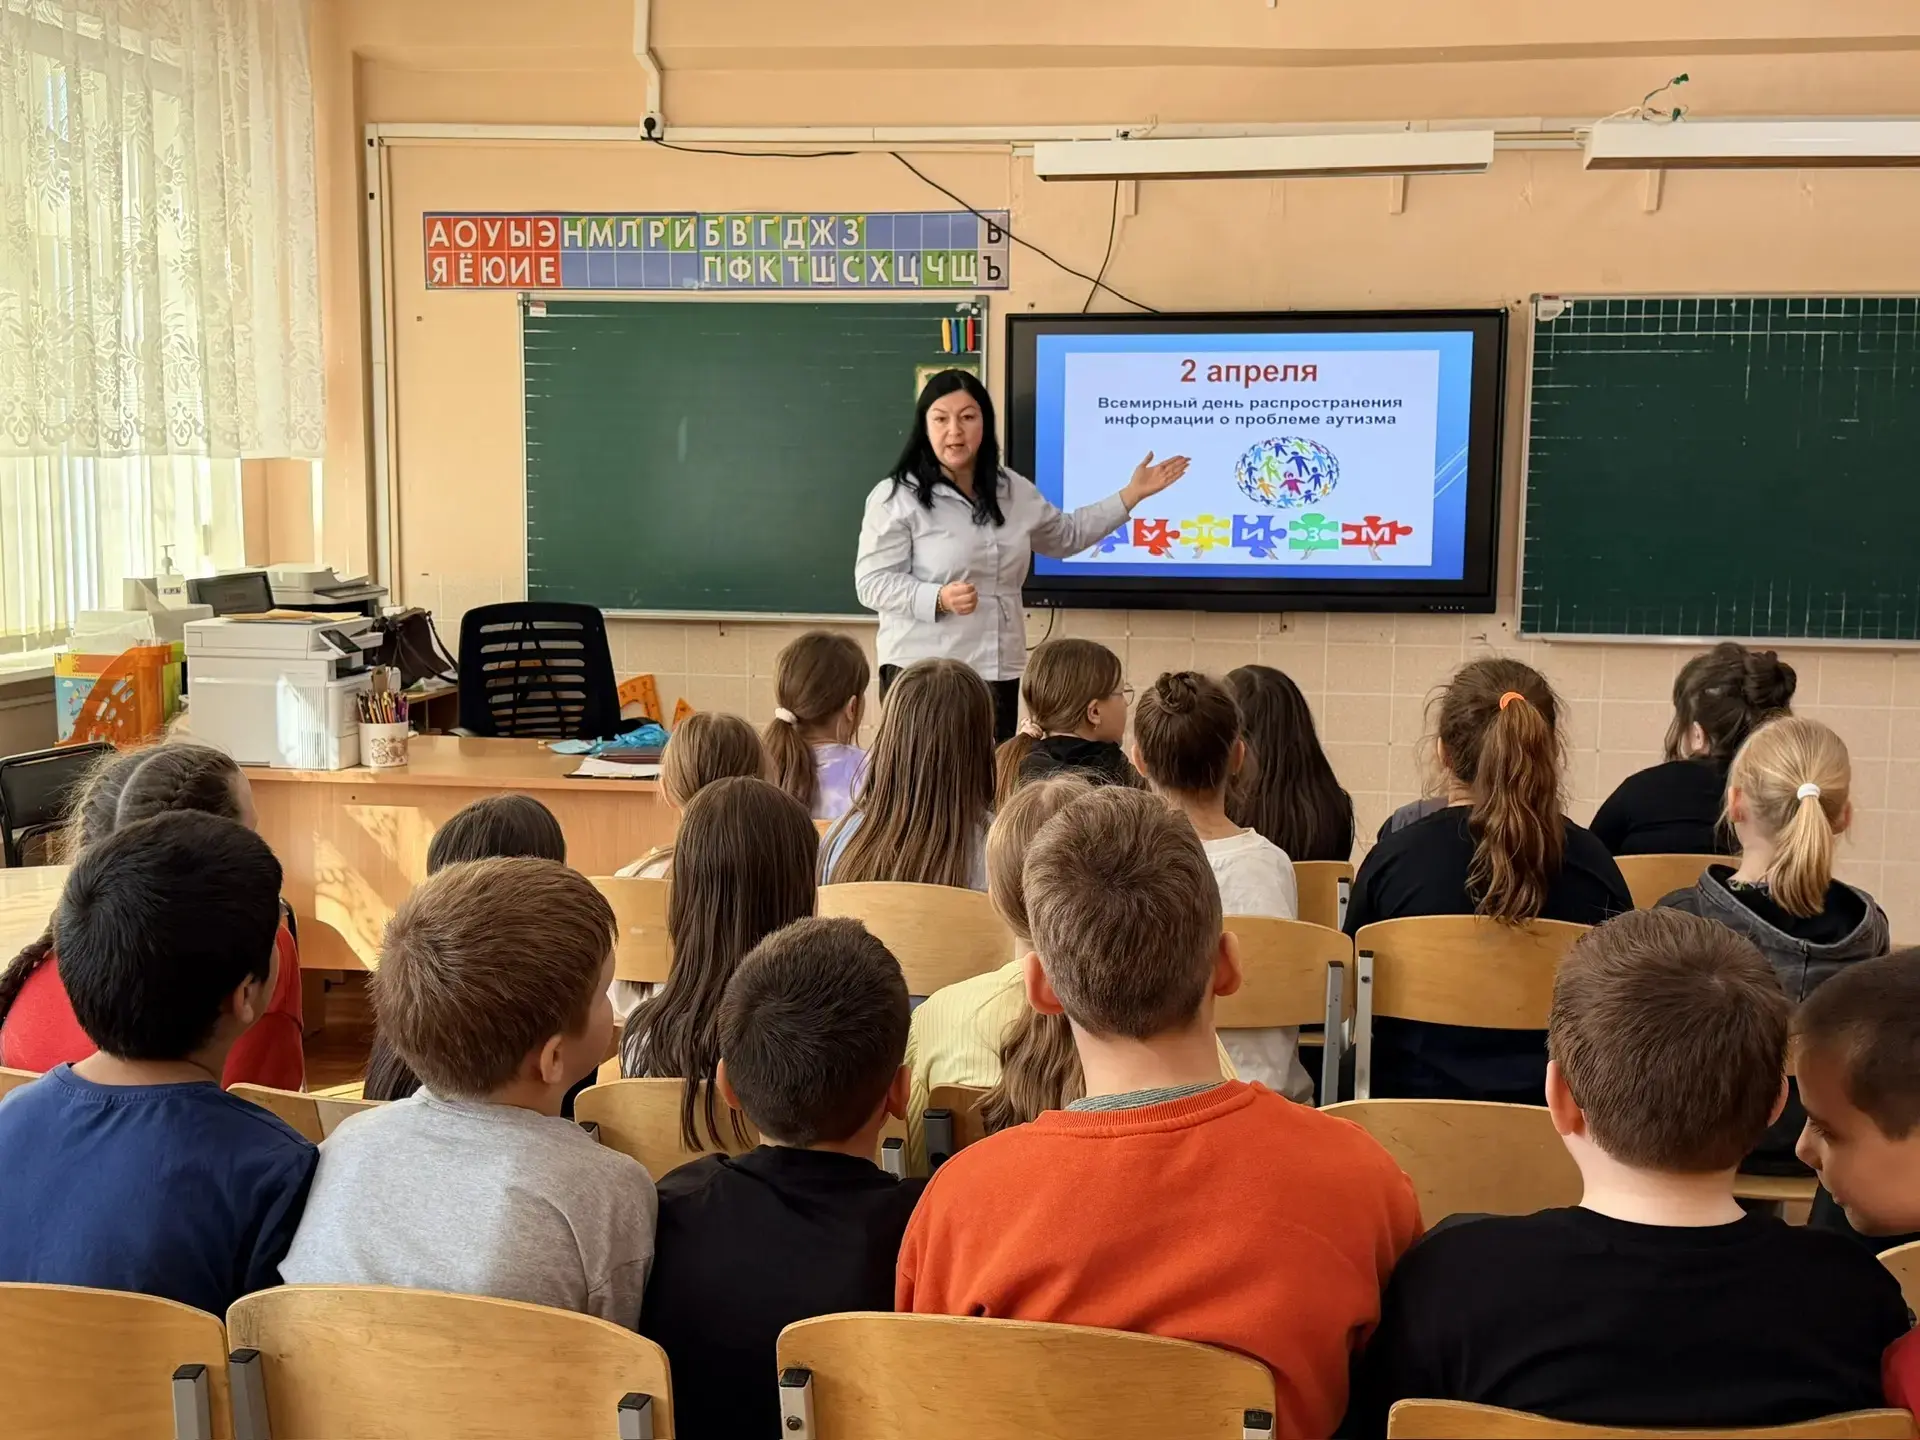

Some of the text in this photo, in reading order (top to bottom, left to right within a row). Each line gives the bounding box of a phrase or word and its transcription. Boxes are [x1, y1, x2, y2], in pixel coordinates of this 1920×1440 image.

[1180, 359, 1317, 389] 2 апреля
[1098, 397, 1402, 411] Всемирный день распространения
[1104, 413, 1396, 428] информации о проблеме аутизма
